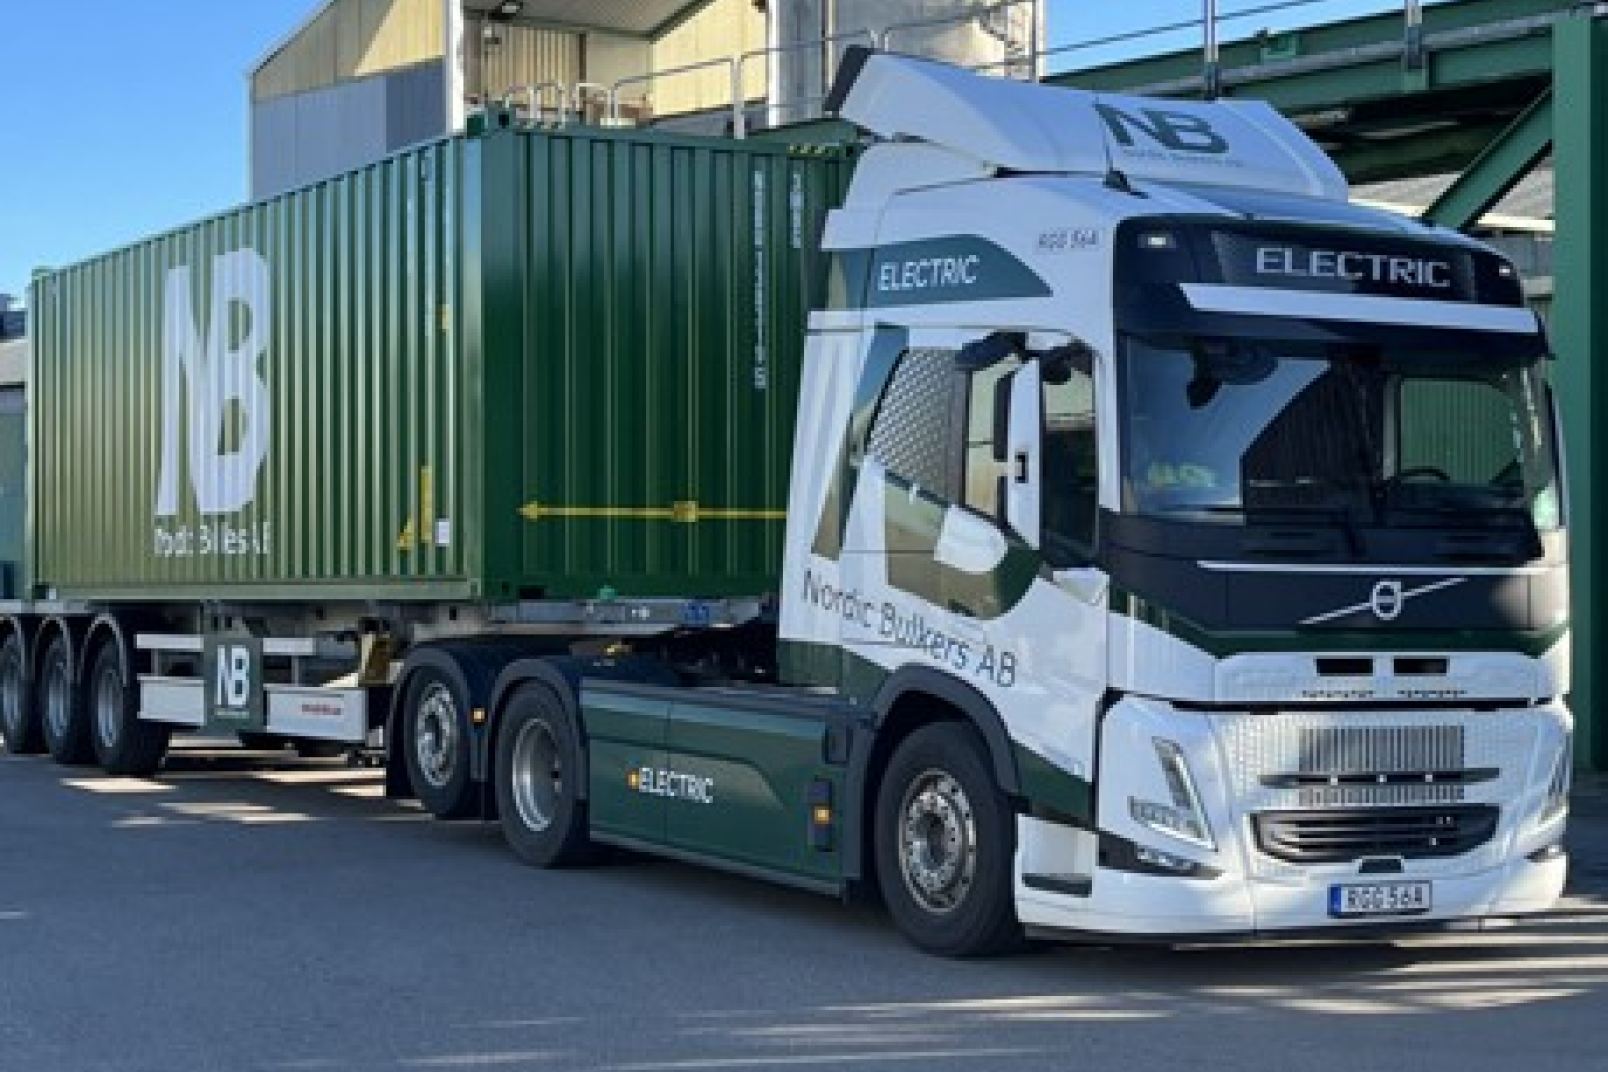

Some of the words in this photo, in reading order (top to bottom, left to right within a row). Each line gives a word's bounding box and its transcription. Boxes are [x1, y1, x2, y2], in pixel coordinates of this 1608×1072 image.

[1092, 101, 1229, 154] NB
[877, 254, 980, 291] ELECTRIC
[1256, 247, 1451, 288] ELECTRIC
[155, 246, 271, 516] NB
[802, 568, 875, 628] Nordic
[880, 602, 970, 670] Bulkers
[975, 644, 1018, 688] AB
[215, 644, 250, 707] NB
[639, 766, 714, 805] ELECTRIC
